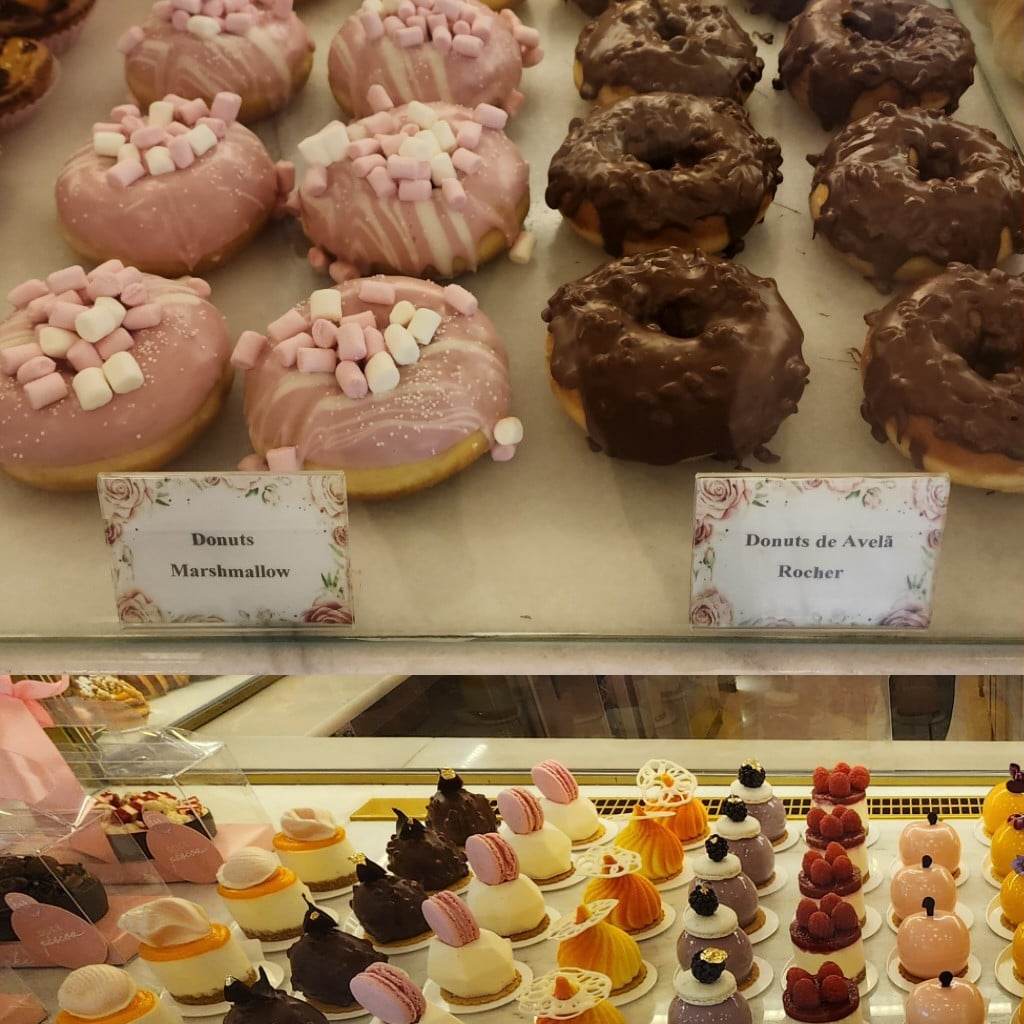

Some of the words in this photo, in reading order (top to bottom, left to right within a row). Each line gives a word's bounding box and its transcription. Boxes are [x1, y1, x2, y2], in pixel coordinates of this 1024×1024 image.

[191, 532, 255, 546] Donuts
[746, 533, 810, 548] Donuts
[816, 534, 838, 548] de
[842, 534, 893, 548] Avelã
[170, 563, 291, 578] Marshmallow
[777, 564, 845, 579] Rocher
